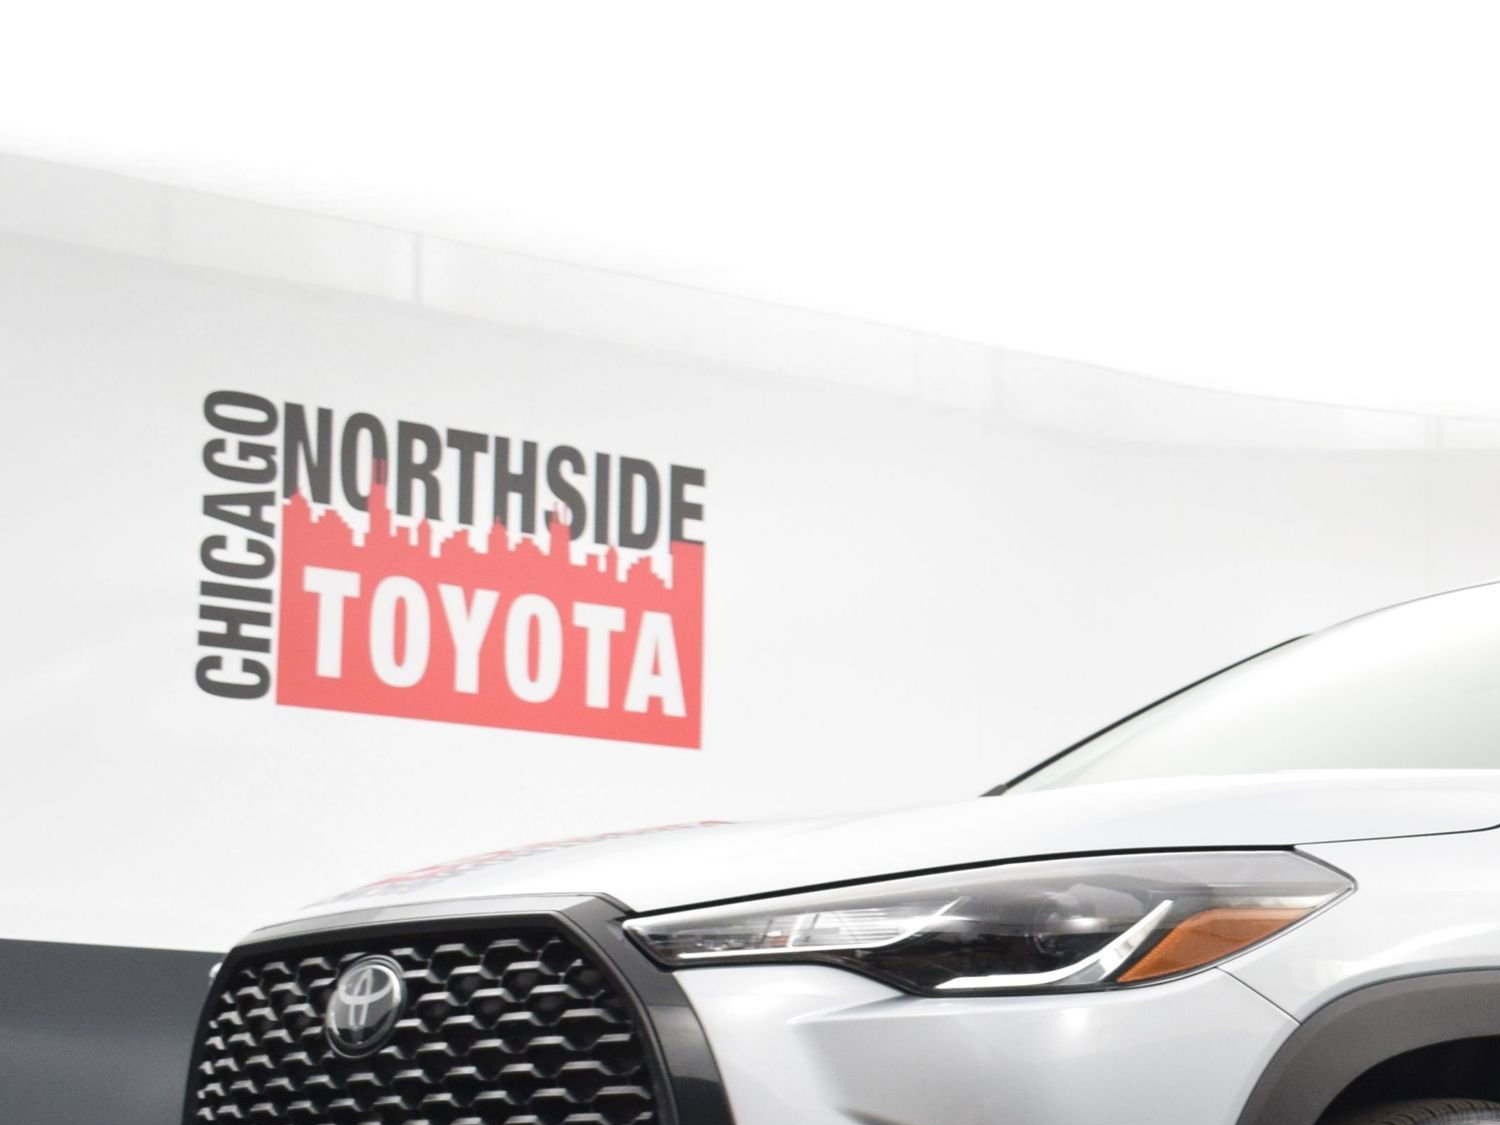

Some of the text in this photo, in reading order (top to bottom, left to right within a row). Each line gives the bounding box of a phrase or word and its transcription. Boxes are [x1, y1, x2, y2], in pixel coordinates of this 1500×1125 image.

[195, 390, 278, 700] CHICAGO
[283, 402, 706, 550] NORTHSIDE
[304, 566, 686, 717] TOYOTA
